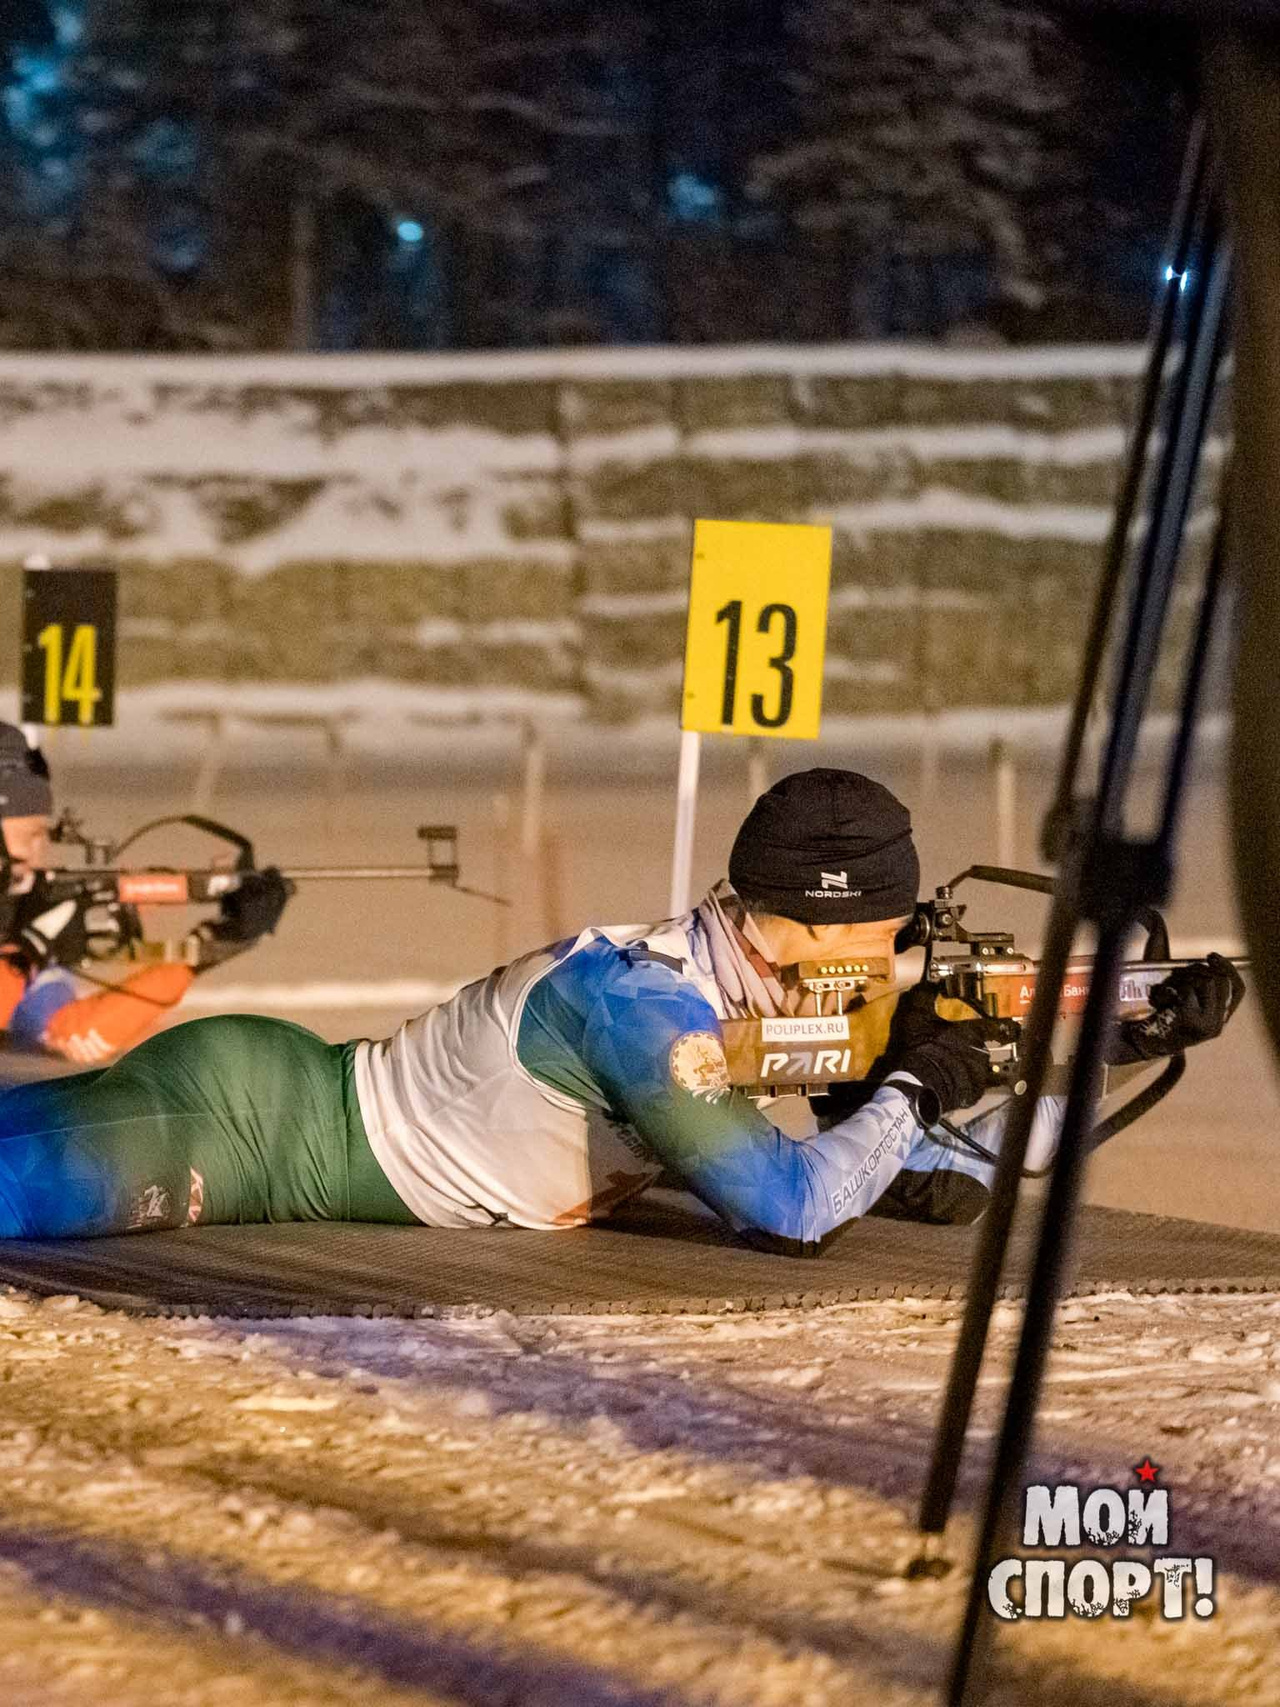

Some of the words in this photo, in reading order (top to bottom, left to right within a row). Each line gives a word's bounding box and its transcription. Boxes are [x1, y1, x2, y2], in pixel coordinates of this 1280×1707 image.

[39, 624, 103, 726] 14
[715, 600, 798, 730] 13
[805, 890, 862, 898] NORDSKI
[765, 1021, 845, 1036] POLIPLEX.RU
[760, 1048, 852, 1078] PARI
[831, 1107, 909, 1216] БАШКОРТОСТАН
